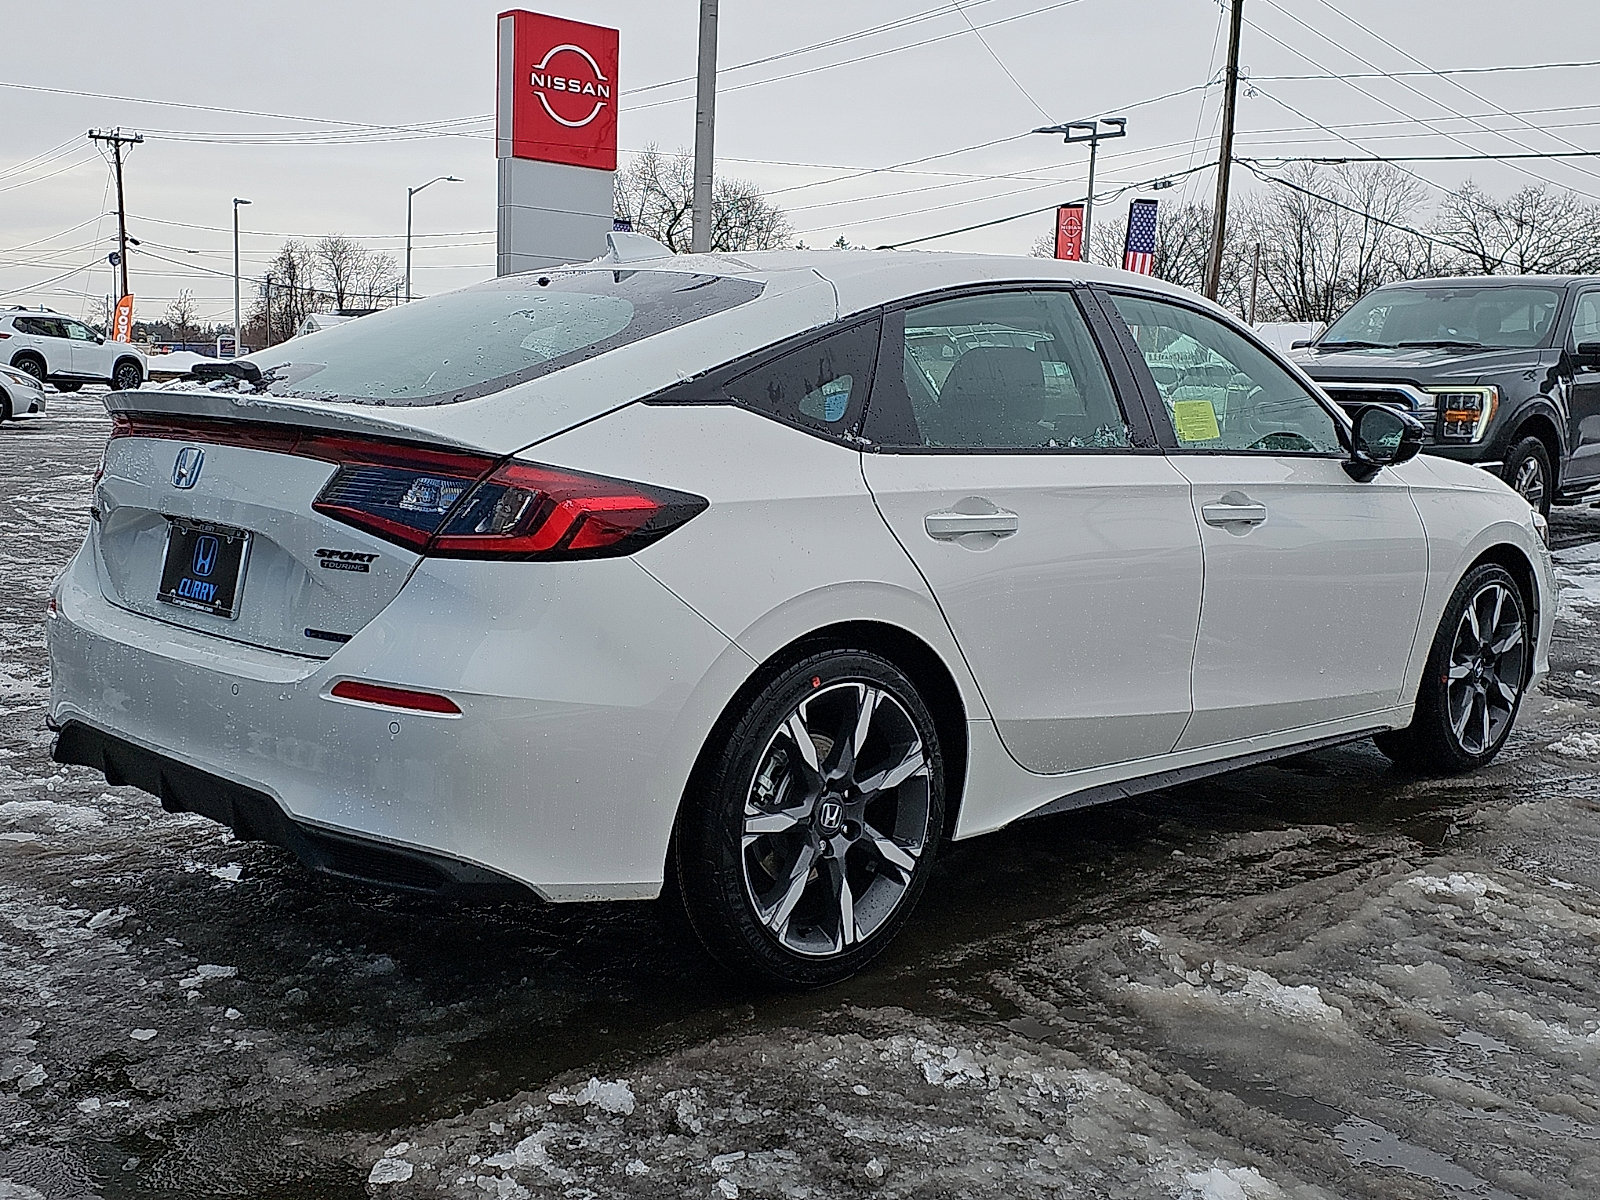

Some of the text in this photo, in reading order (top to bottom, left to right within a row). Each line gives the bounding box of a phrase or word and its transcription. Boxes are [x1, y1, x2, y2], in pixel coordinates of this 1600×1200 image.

[531, 72, 610, 98] NISSAN
[314, 548, 380, 563] SPORT
[322, 560, 365, 572] TOURING
[177, 577, 218, 602] CURRY
